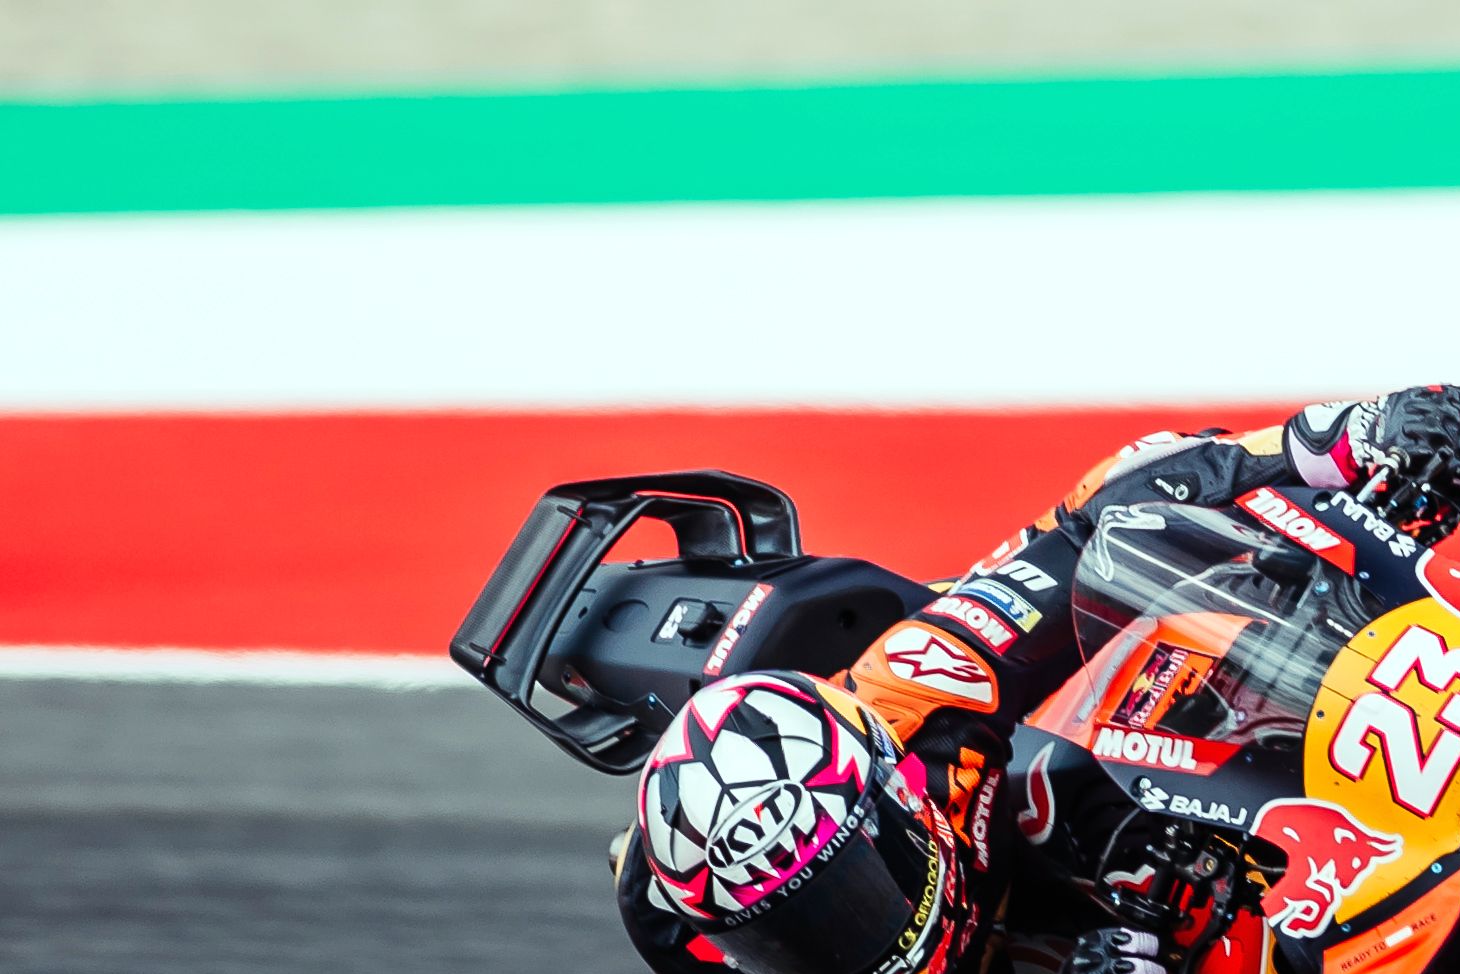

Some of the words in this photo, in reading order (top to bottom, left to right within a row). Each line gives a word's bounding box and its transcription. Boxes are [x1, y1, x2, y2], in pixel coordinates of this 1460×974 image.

[1245, 488, 1340, 550] MOTUL
[1330, 491, 1397, 545] BAJAJ
[1095, 728, 1198, 769] MOTUL
[707, 787, 785, 868] KYT
[972, 773, 1000, 868] MOTUL
[1170, 796, 1247, 825] BAJAJ
[725, 899, 772, 927] GIVES
[777, 866, 814, 897] YOU
[817, 804, 865, 863] WINGS
